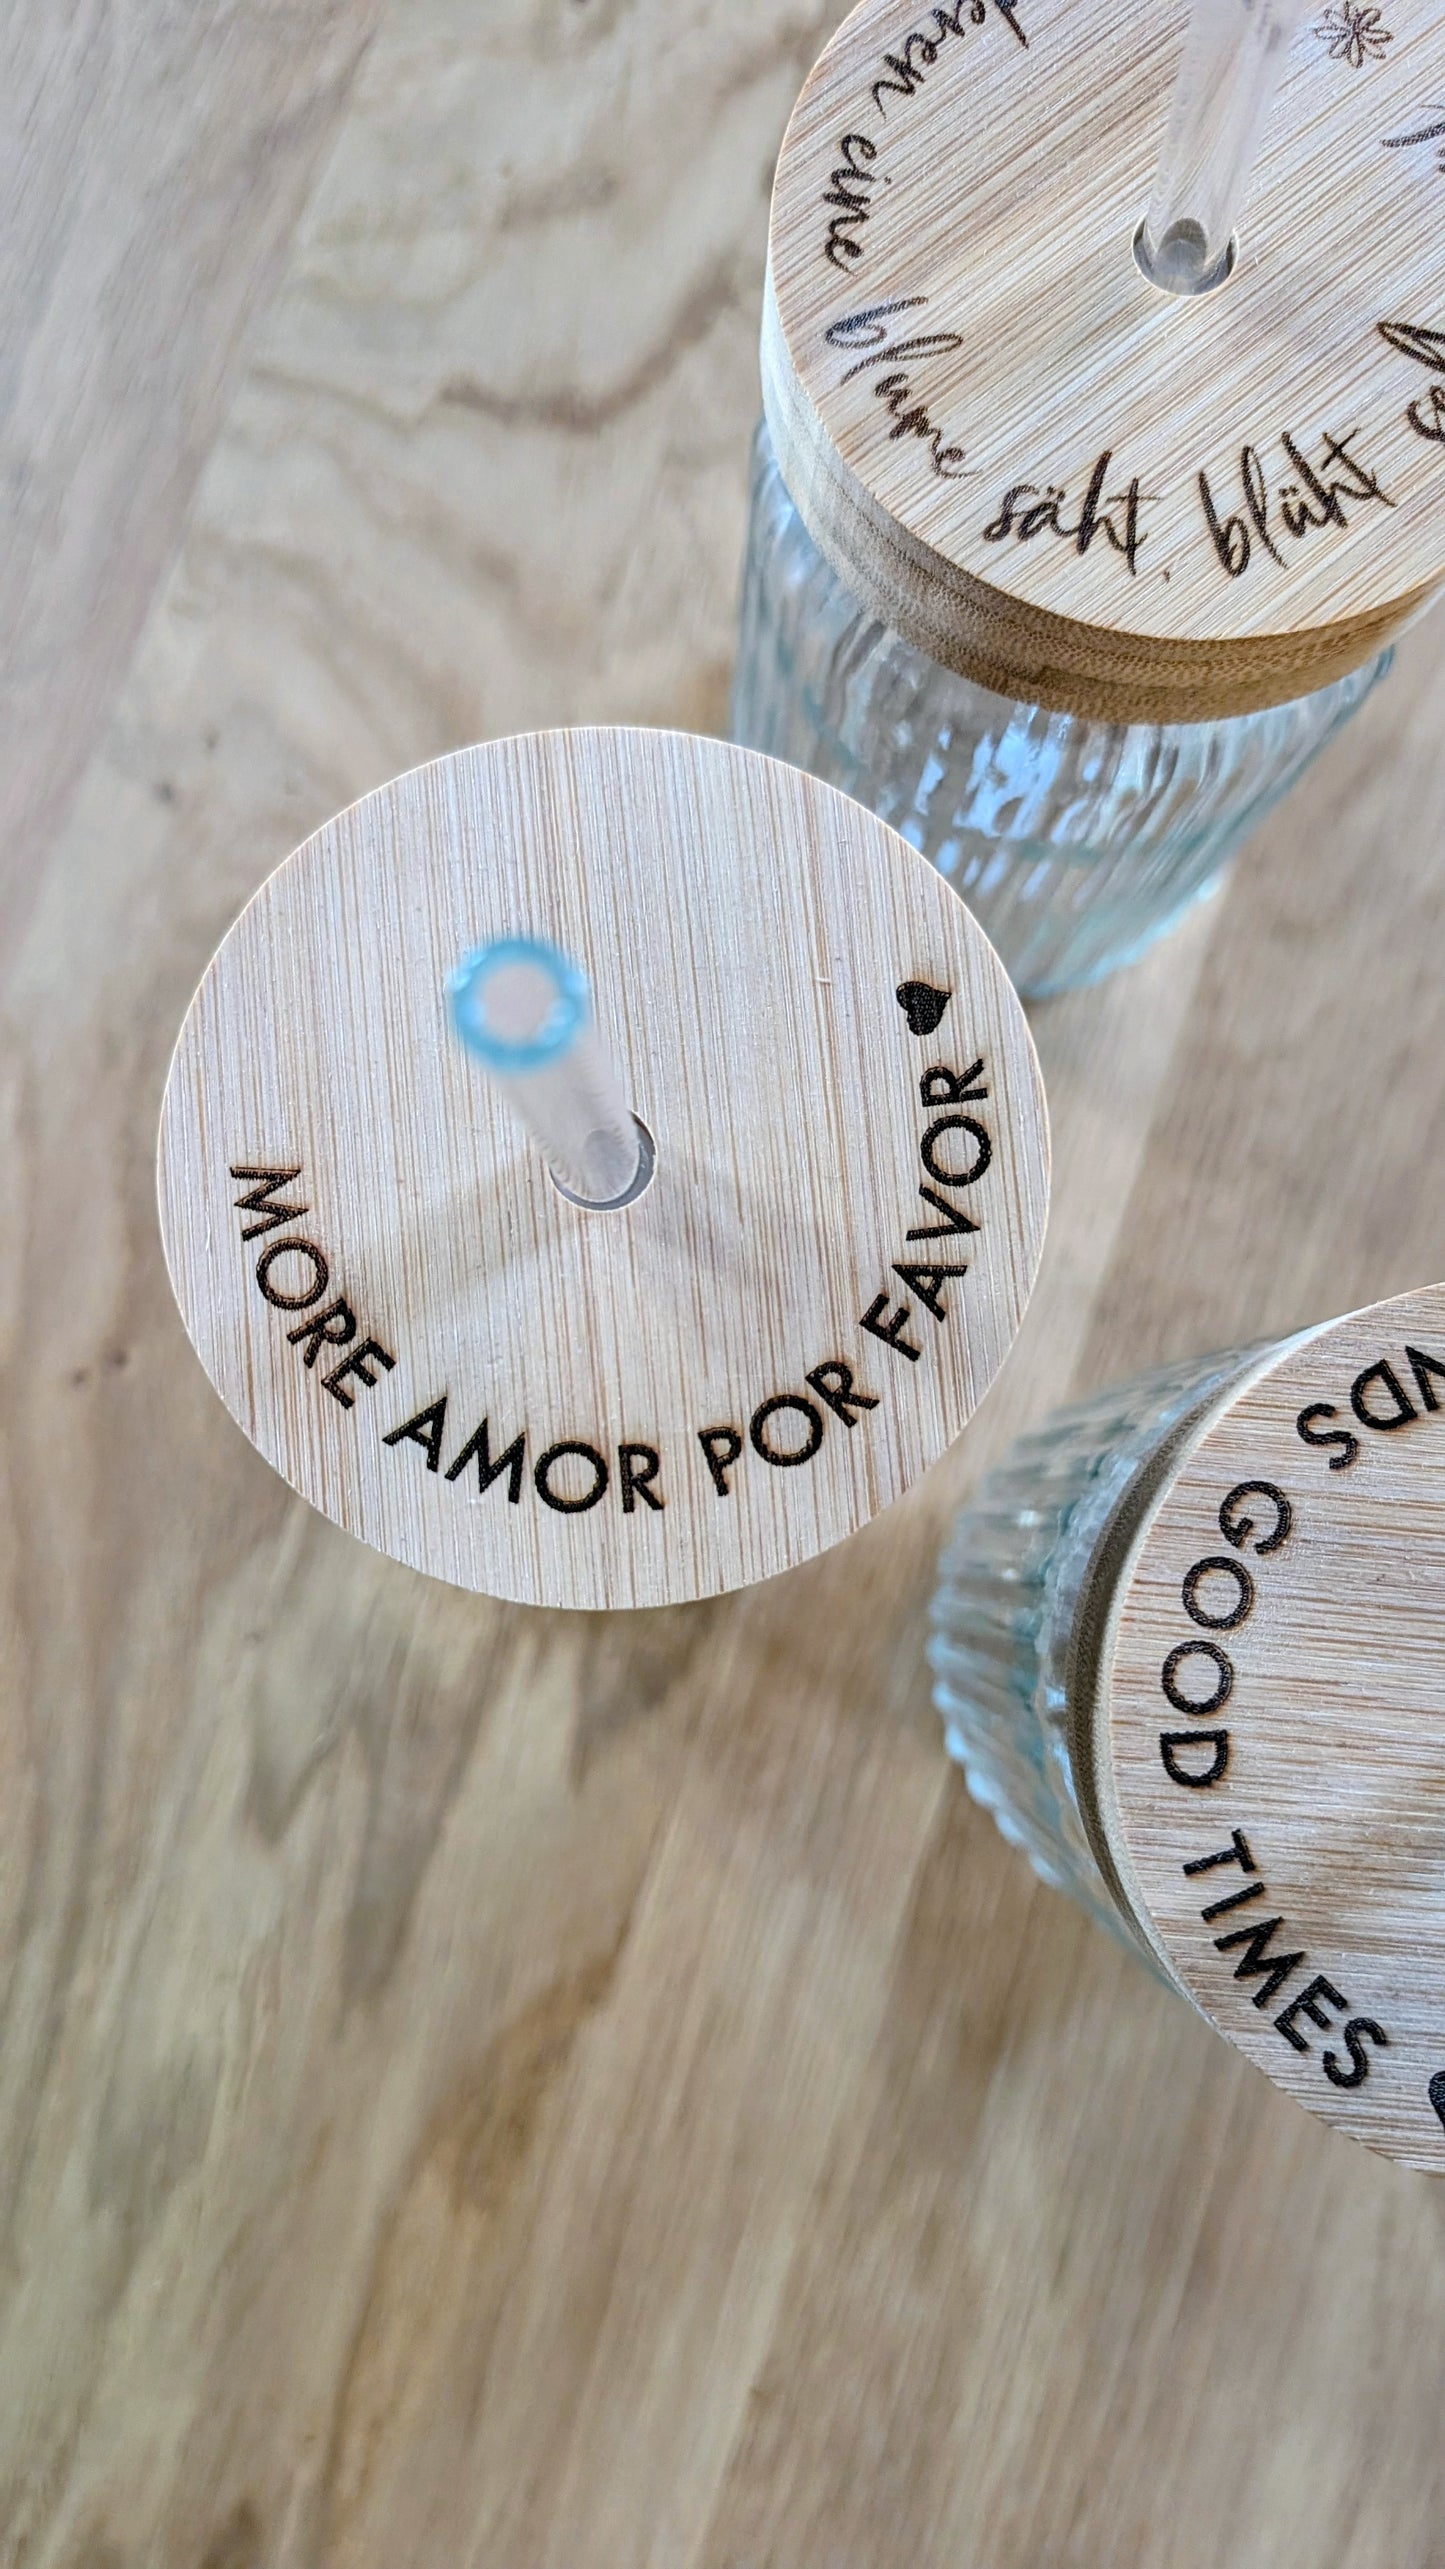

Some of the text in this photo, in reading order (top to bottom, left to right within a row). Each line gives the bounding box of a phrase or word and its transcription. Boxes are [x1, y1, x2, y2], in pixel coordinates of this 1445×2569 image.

[821, 132, 892, 276] eine
[1198, 427, 1397, 578] blüht
[229, 1058, 992, 1514] MORE AMOR POR FAVOR
[1160, 1479, 1293, 1788] GOOD
[1183, 1829, 1388, 2089] TIMES
